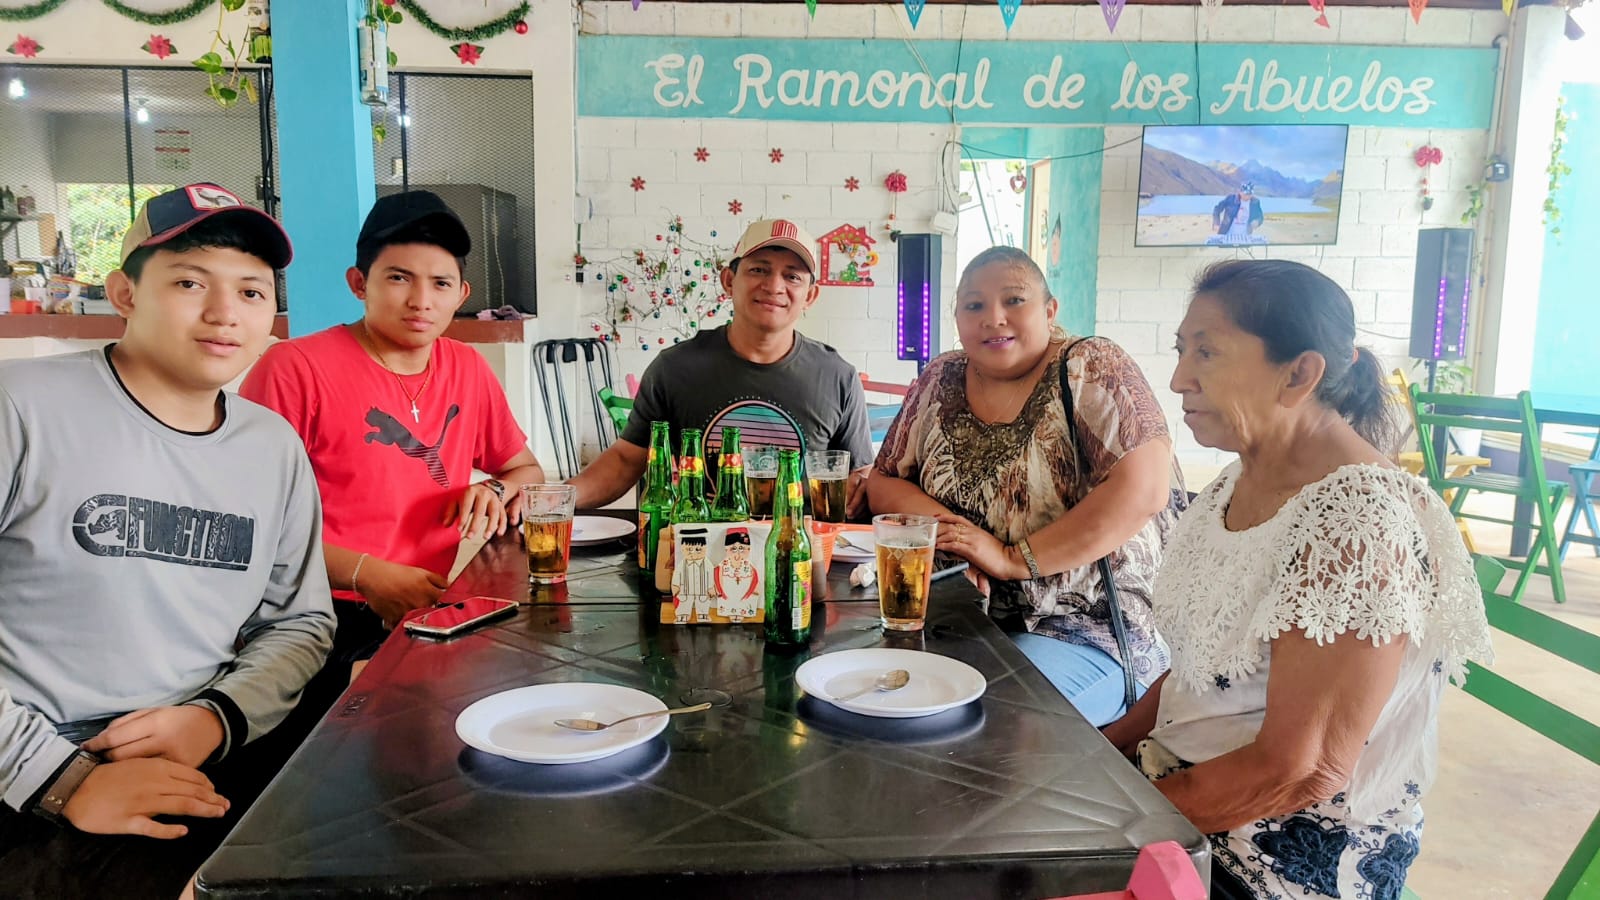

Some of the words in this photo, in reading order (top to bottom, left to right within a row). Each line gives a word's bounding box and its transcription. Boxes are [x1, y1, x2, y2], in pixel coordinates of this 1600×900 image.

[644, 53, 704, 108] El
[728, 53, 994, 114] Ramonal
[1023, 55, 1086, 109] de
[1111, 60, 1193, 111] los
[1210, 58, 1437, 115] Abuelos
[127, 496, 255, 565] FUNCTION
